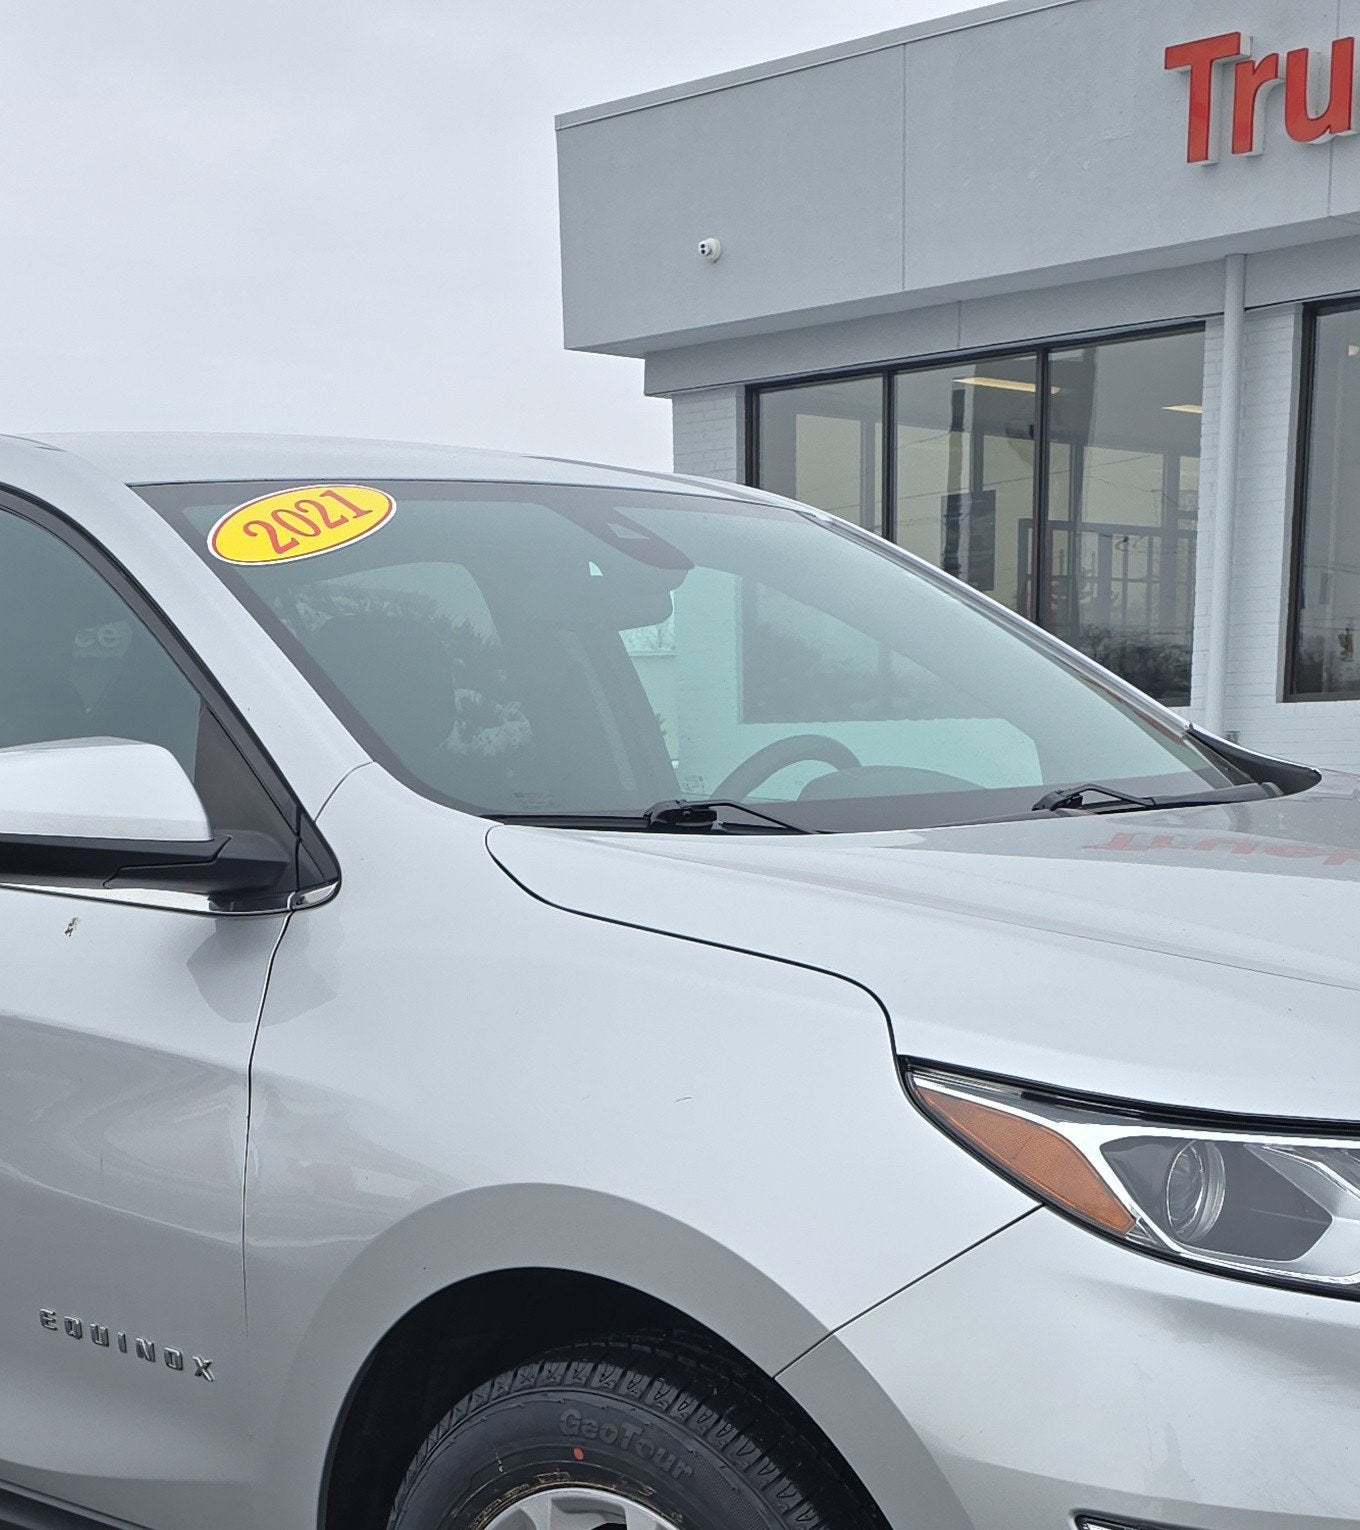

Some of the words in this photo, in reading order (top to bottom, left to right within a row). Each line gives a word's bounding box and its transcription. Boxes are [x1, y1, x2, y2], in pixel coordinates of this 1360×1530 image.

[243, 490, 373, 554] 2021
[39, 1308, 215, 1382] EQUINOX
[559, 1409, 693, 1479] GeoTour
